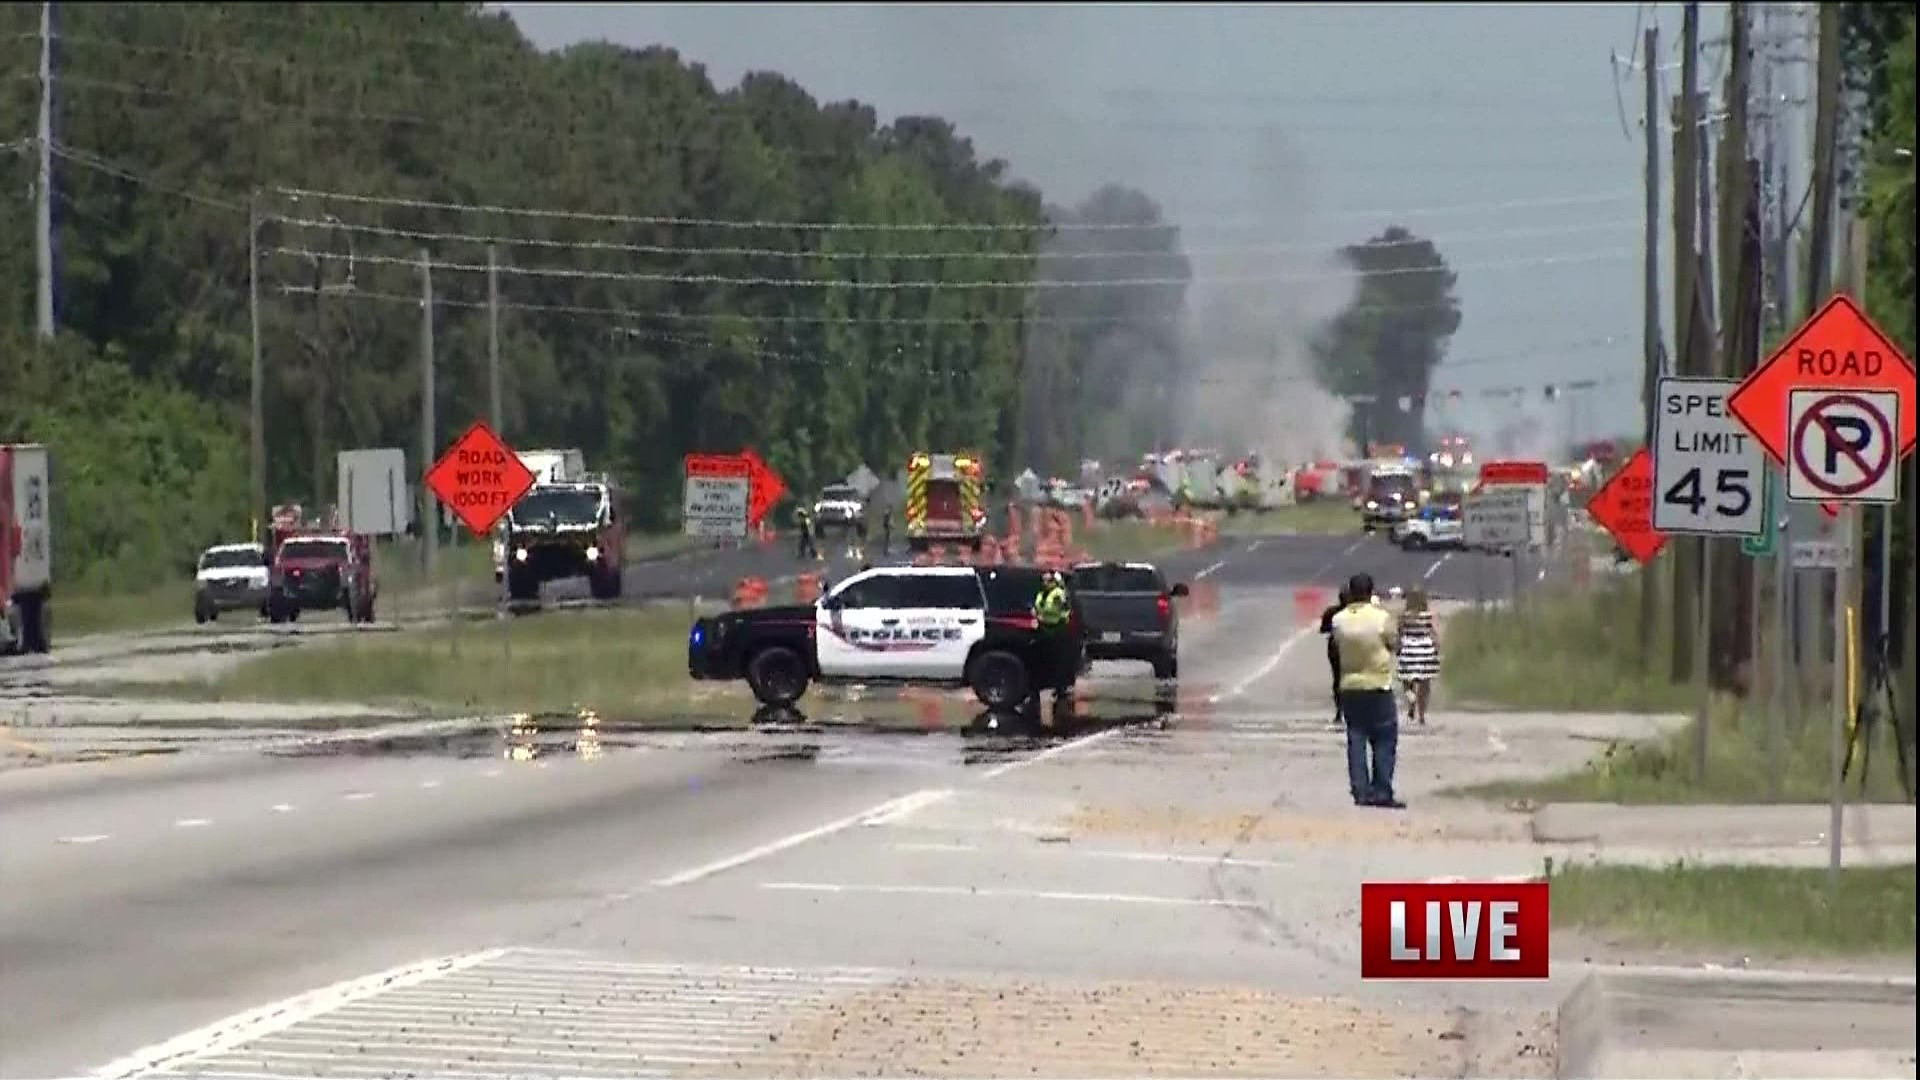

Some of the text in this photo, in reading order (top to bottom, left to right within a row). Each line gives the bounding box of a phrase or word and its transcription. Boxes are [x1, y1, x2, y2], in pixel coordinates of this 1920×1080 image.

[1798, 349, 1883, 376] ROAD
[1667, 394, 1731, 417] SPE
[1675, 430, 1749, 456] LIMIT
[458, 450, 506, 465] ROAD
[456, 469, 503, 485] WORK
[1663, 467, 1752, 517] 45
[849, 627, 962, 641] POLICE
